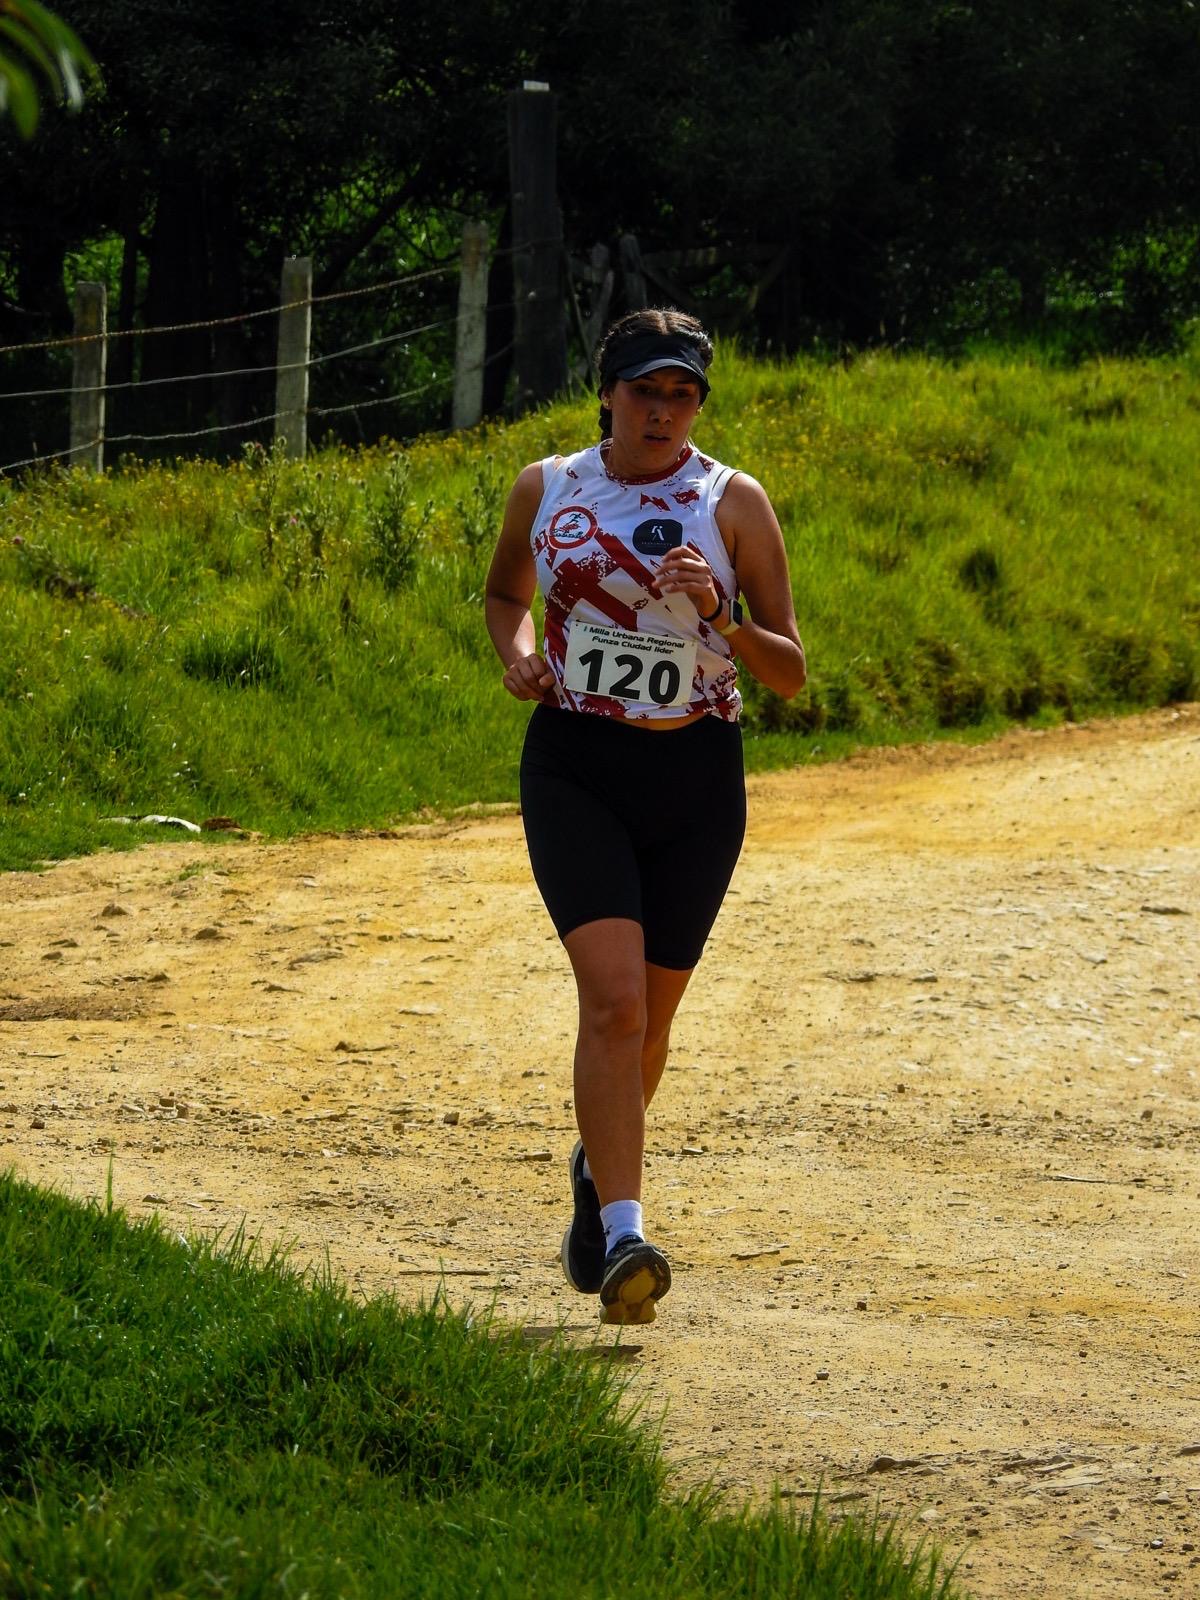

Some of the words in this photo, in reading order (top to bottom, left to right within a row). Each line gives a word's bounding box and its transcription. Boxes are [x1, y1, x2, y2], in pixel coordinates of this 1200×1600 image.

[589, 626, 610, 636] Milla
[612, 629, 645, 642] Urbana
[647, 636, 685, 649] Regional
[592, 635, 619, 646] Funza
[621, 640, 652, 652] Ciudad
[578, 648, 681, 705] 120
